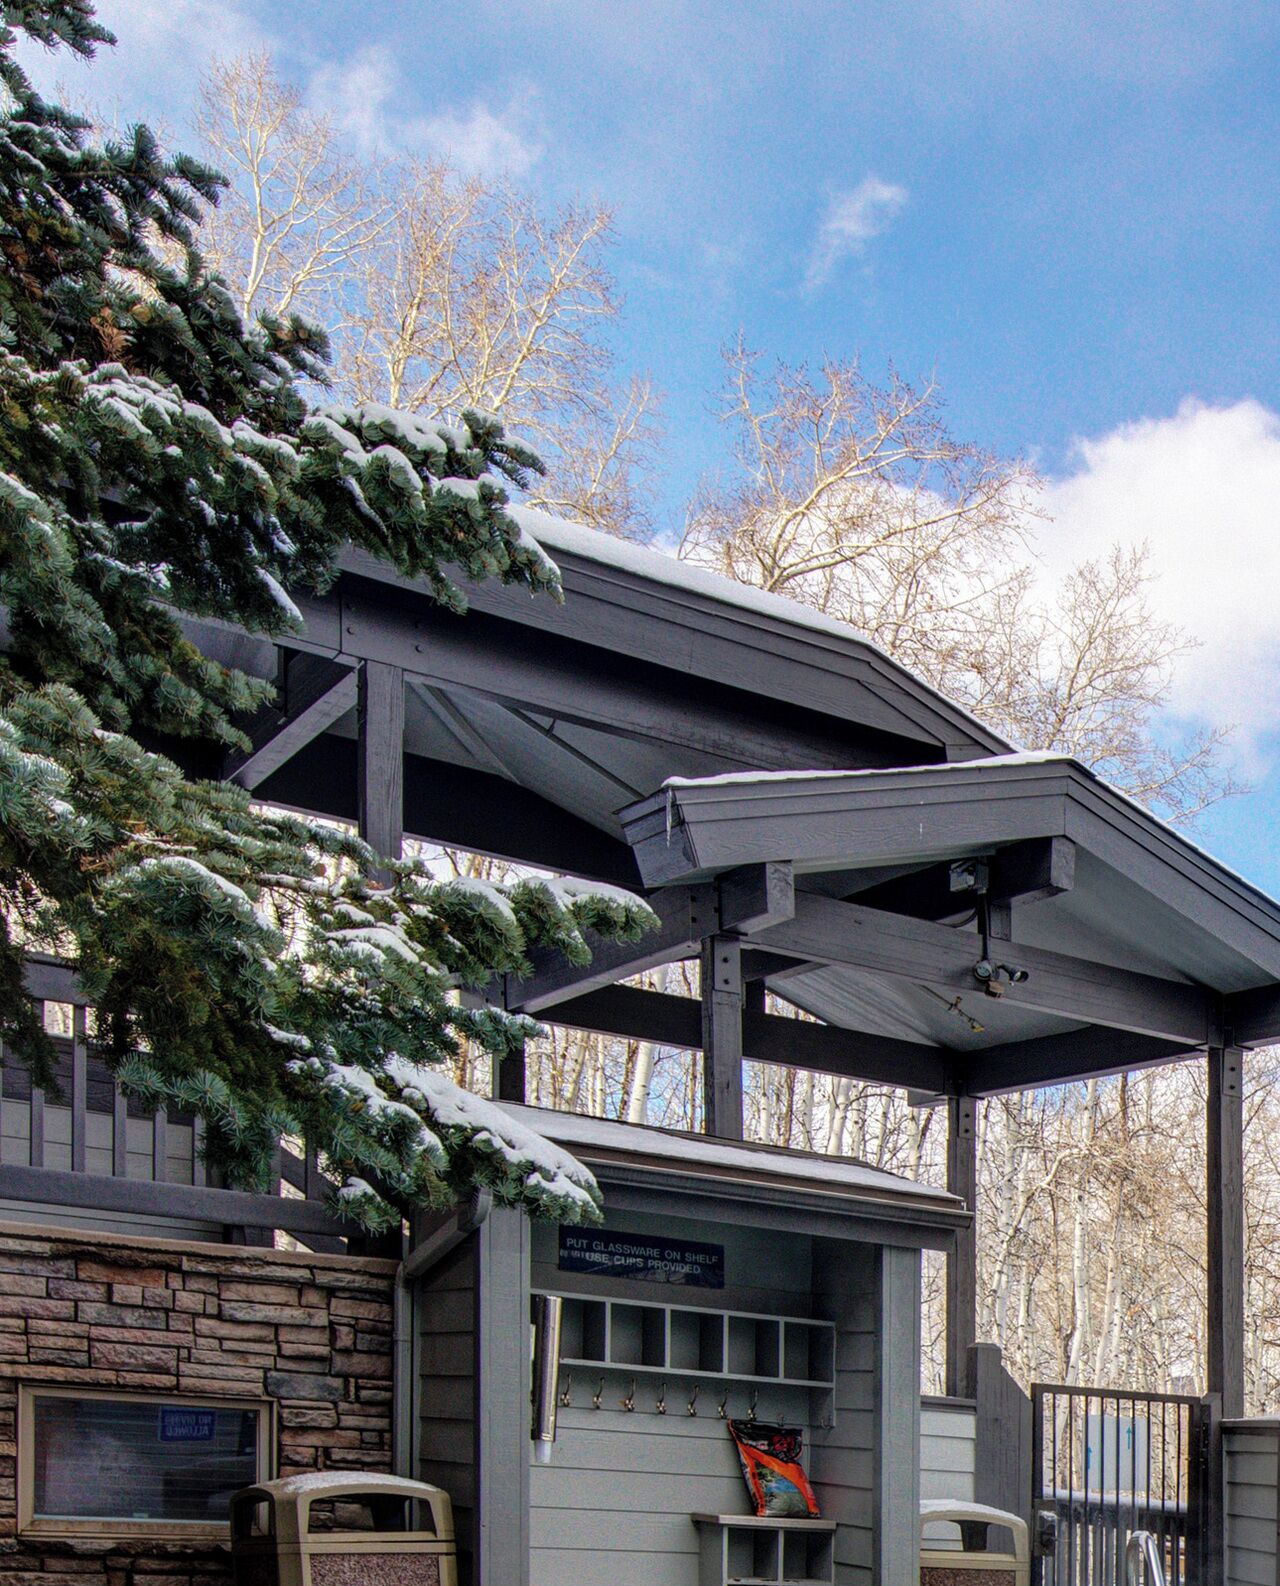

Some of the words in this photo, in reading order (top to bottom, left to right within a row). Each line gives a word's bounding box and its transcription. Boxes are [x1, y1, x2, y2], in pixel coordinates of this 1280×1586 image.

[566, 1237, 589, 1249] PUT
[592, 1241, 661, 1258] GLASSWARE
[665, 1250, 681, 1261] ON
[685, 1252, 718, 1265] SHELF
[586, 1251, 609, 1263] USE
[613, 1255, 644, 1268] CUPS
[648, 1260, 701, 1274] PROVIDED
